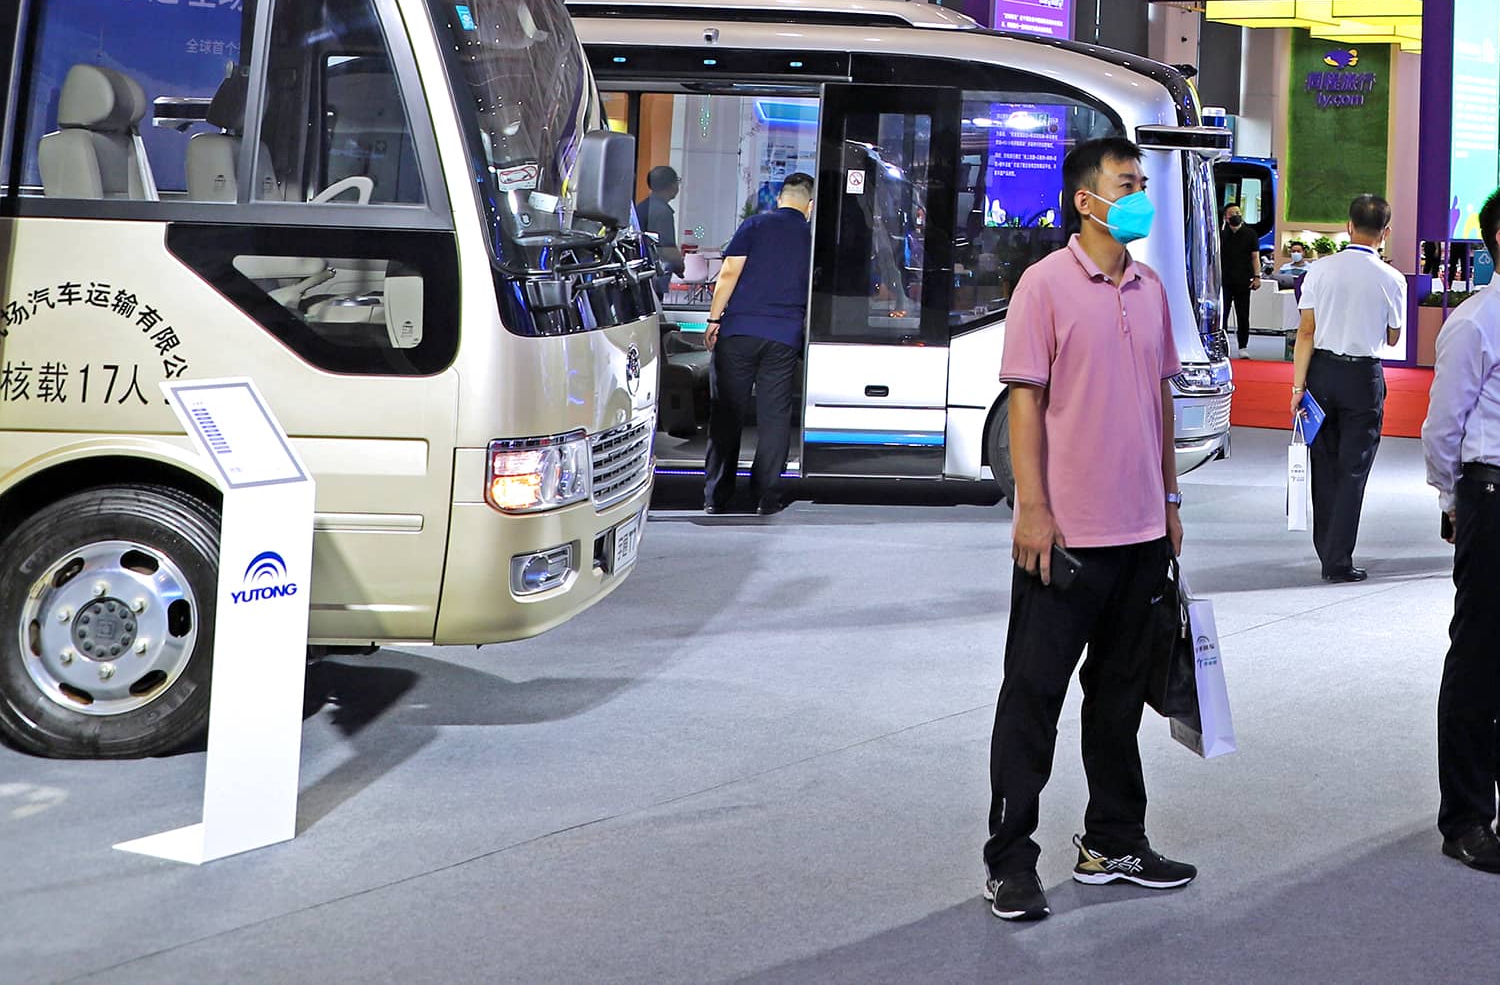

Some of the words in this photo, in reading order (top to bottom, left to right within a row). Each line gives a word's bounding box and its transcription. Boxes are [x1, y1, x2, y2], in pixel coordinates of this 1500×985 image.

[186, 38, 241, 55] 全球首个
[231, 583, 298, 605] YUTONG
